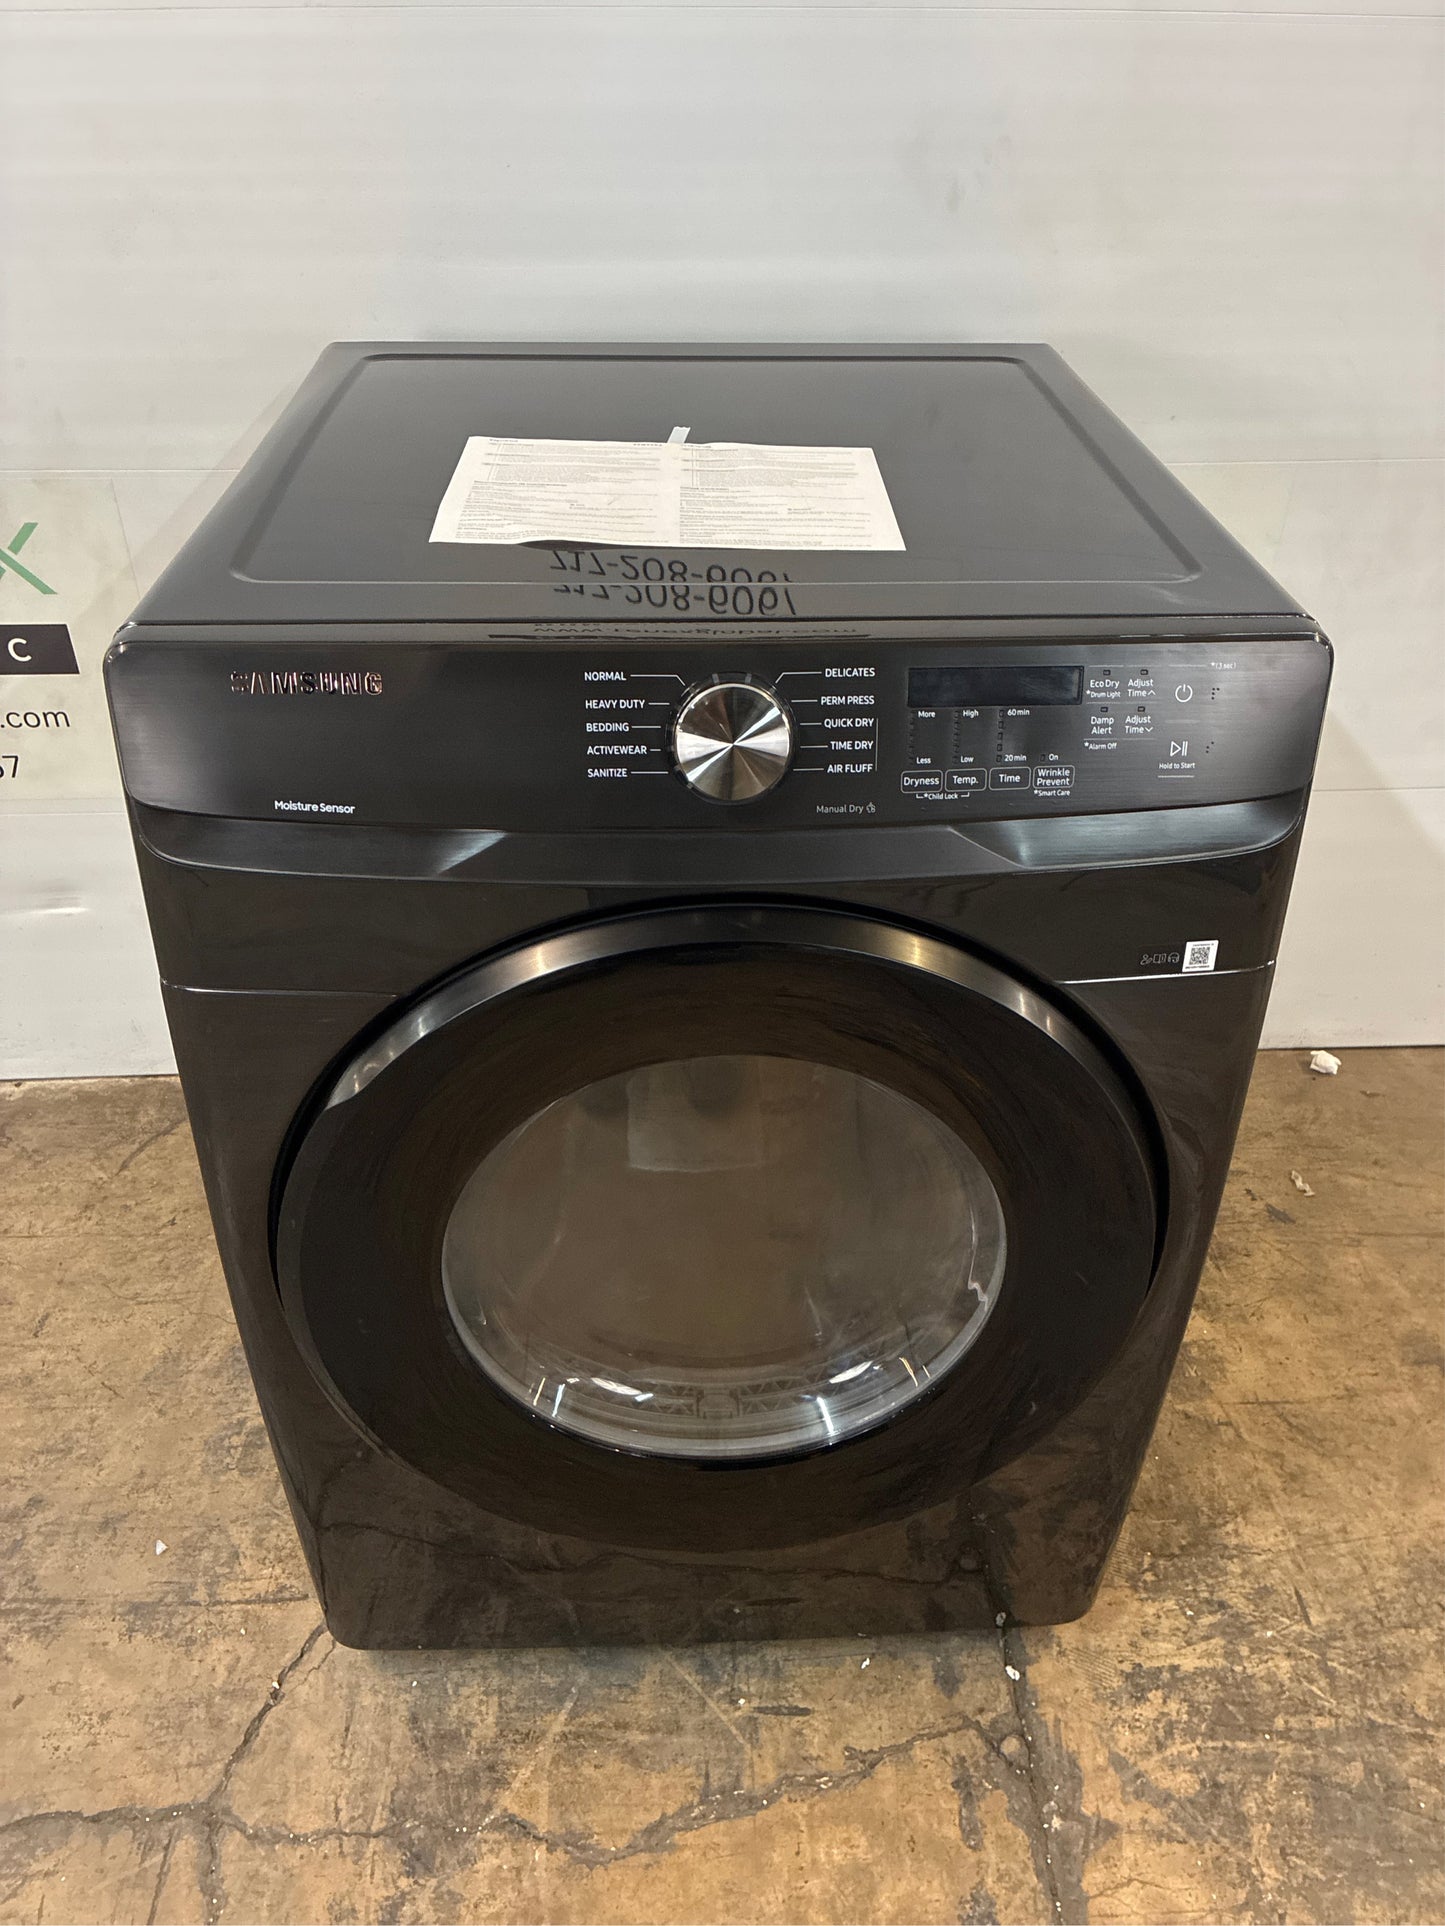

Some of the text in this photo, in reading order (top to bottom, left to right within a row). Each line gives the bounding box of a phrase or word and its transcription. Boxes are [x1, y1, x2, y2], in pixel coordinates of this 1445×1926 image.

[7, 638, 32, 662] C
[584, 671, 627, 682] NORMAL
[825, 667, 876, 678] DELICATES
[230, 671, 383, 695] SAMSUNG
[1090, 679, 1120, 689] Eco Dry
[1127, 678, 1154, 688] Adjust
[1127, 689, 1147, 697] Time
[585, 699, 645, 710] HEAVY DUTY
[820, 695, 875, 706] PERM PRESS
[918, 710, 936, 718] More
[963, 709, 979, 718] High
[1016, 708, 1030, 716] min
[0, 711, 71, 729] .com
[824, 718, 875, 729] QUICK DRY
[1090, 716, 1114, 726] Damp
[1125, 715, 1151, 725] Adjust
[586, 723, 630, 733] BEDDING
[1091, 726, 1112, 735] Alert
[1125, 725, 1144, 734] Time
[587, 745, 648, 755] ACTIVEWEAR
[830, 740, 874, 750] TIME DRY
[1107, 742, 1117, 750] Off
[916, 756, 931, 764] Less
[587, 768, 628, 778] SANITIZE
[827, 764, 874, 774] AIR FLUFF
[1037, 768, 1071, 777] Wrinkle
[903, 776, 940, 787] Dryness
[952, 775, 979, 785] Temp.
[999, 774, 1021, 783] Time
[1036, 777, 1070, 786] Prevent
[274, 800, 356, 815] Moisture Sensor
[816, 804, 864, 816] Manual Dry
